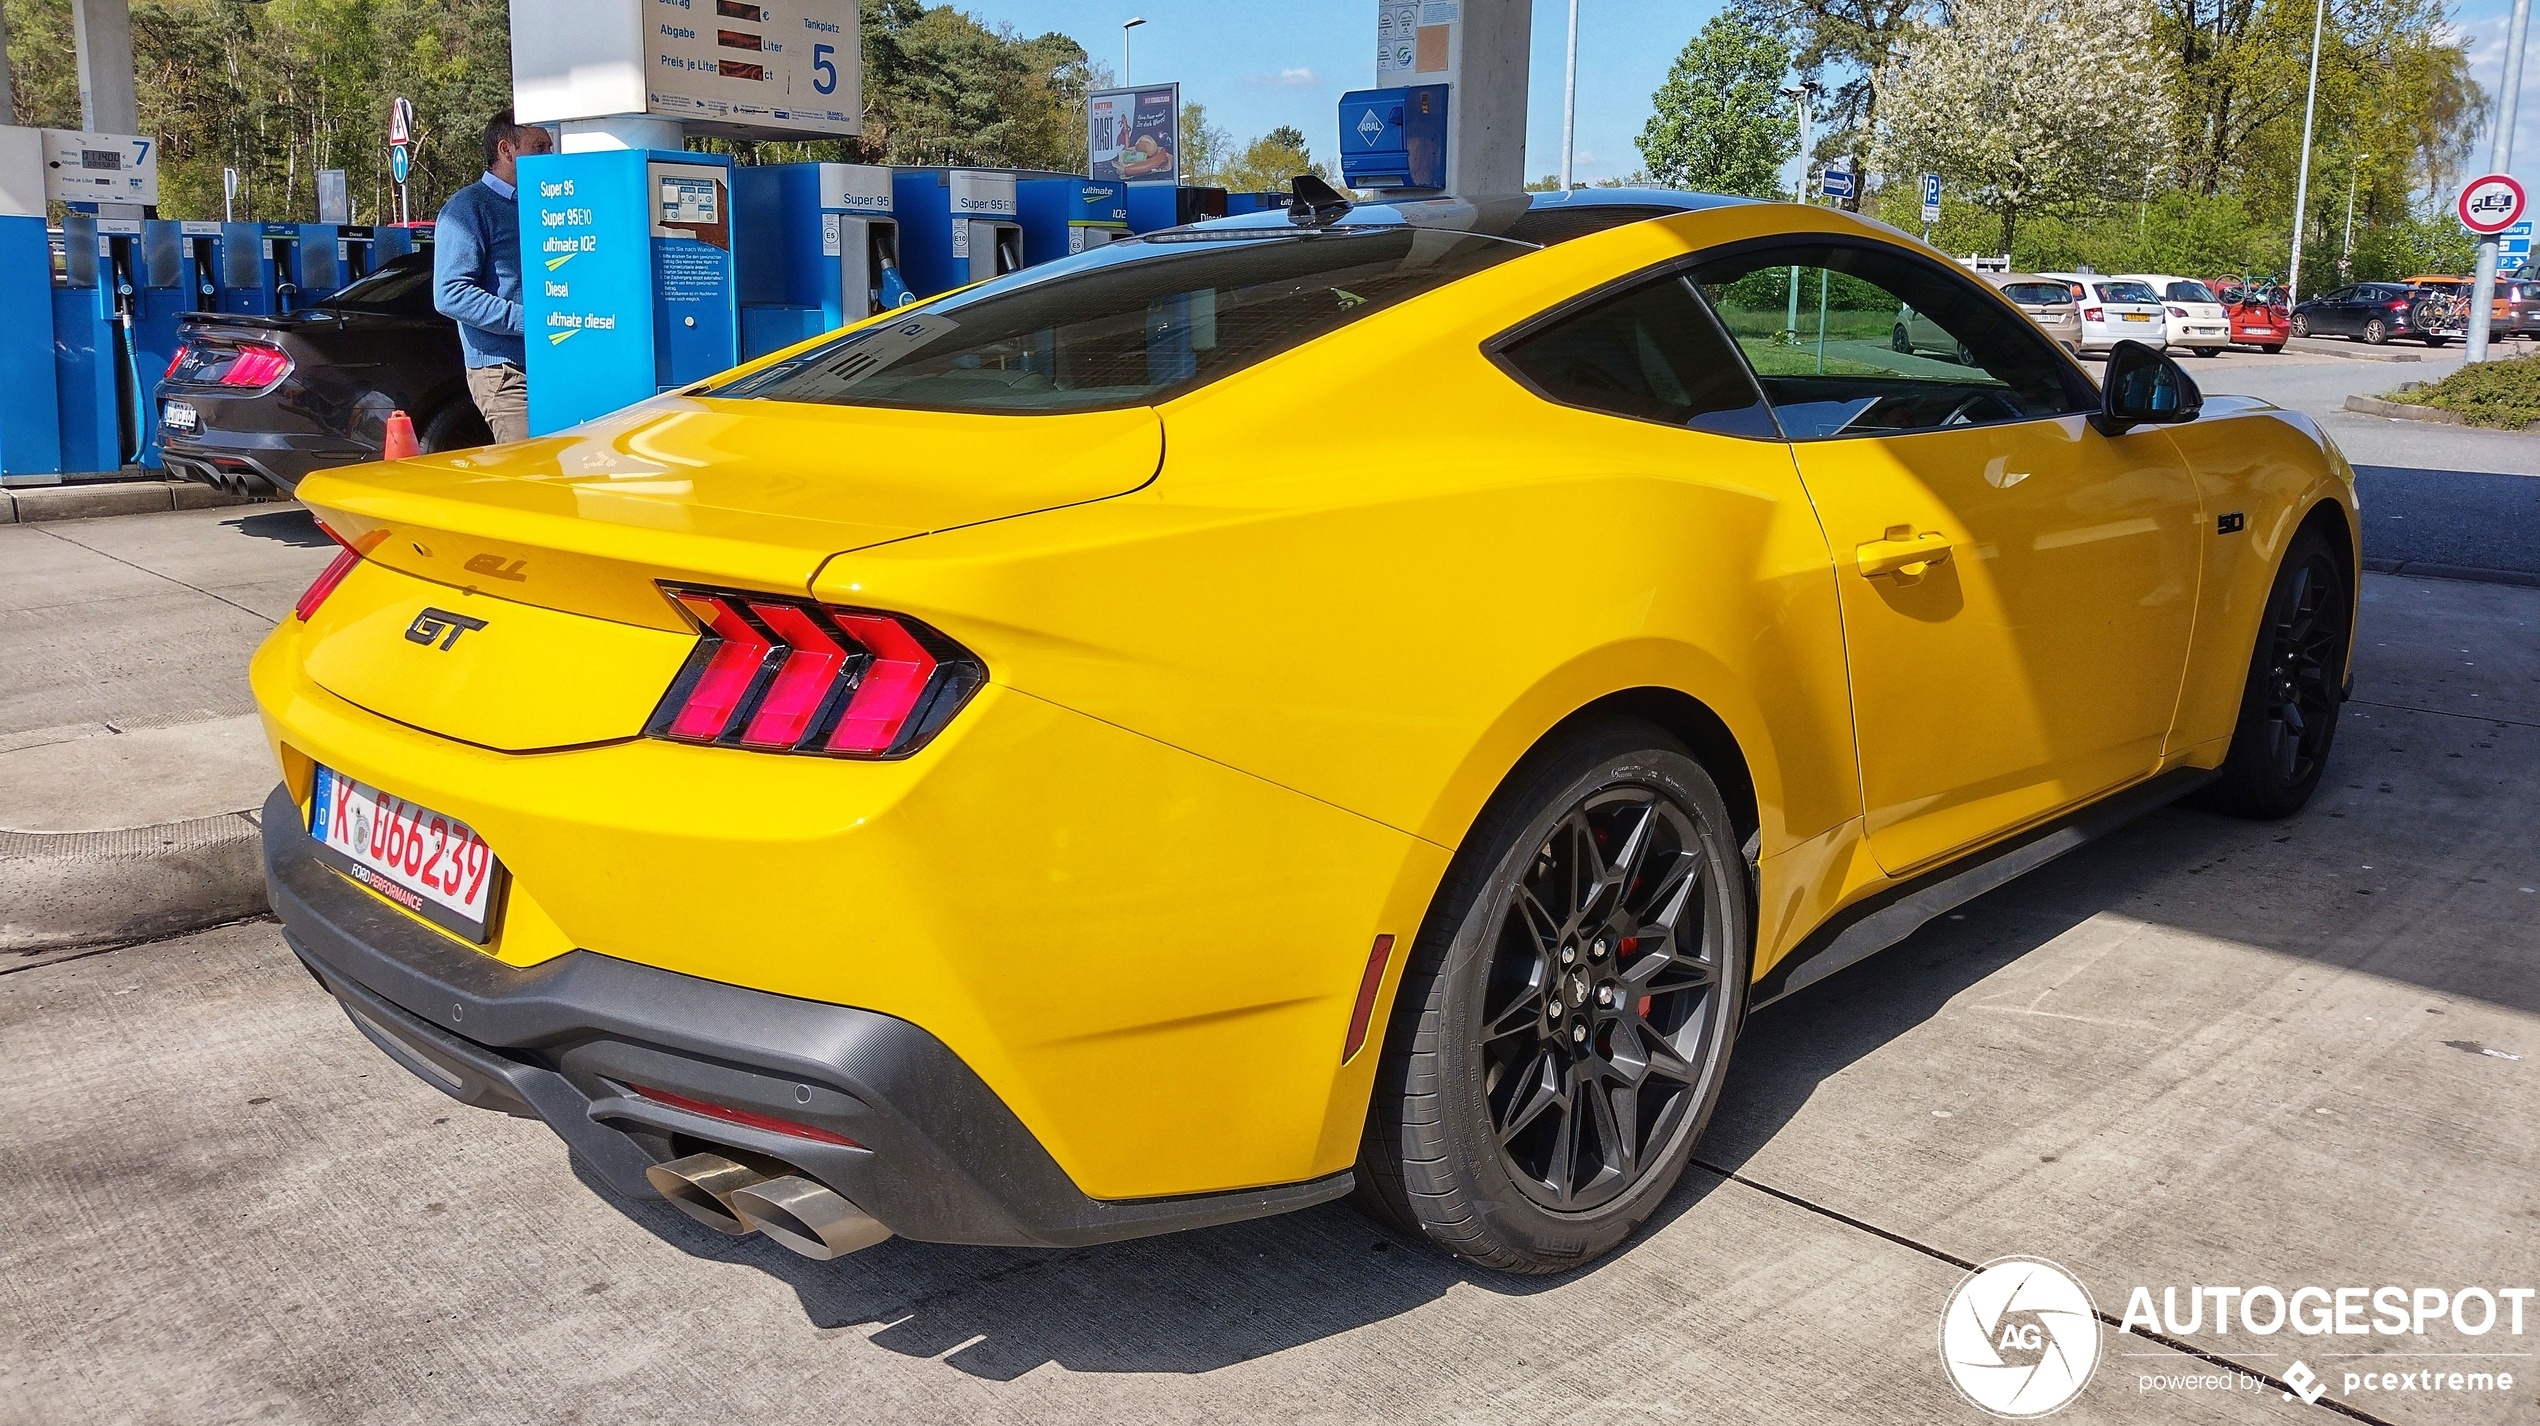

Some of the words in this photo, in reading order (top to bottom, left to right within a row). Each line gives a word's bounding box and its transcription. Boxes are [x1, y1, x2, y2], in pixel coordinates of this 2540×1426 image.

[659, 0, 690, 10] etrag
[762, 11, 770, 21] €
[660, 24, 695, 38] Abgabe
[804, 18, 840, 34] Tankplatz
[763, 41, 783, 53] Liter
[661, 55, 684, 68] Preis
[687, 58, 695, 71] je
[698, 60, 717, 72] Liter
[813, 44, 837, 95] 5
[764, 70, 774, 80] ct
[1094, 117, 1113, 151] RAST
[1361, 122, 1380, 132] ARAL
[132, 140, 150, 166] 7
[540, 181, 562, 199] Super
[564, 180, 574, 196] 95
[1082, 186, 1114, 195] ultimate
[844, 193, 874, 206] Super
[877, 196, 889, 206] 95
[960, 197, 988, 210] Super
[541, 208, 565, 229] Super
[1112, 208, 1127, 218] 102
[543, 237, 578, 252] ultimate
[580, 236, 596, 251] 102
[545, 281, 569, 297] Diesel
[547, 312, 582, 328] ultimate
[584, 313, 615, 329] diesel
[404, 607, 490, 652] GT
[319, 808, 326, 826] D
[334, 776, 356, 845] K
[351, 863, 371, 883] FORD
[368, 874, 423, 912] PERFORMANCE
